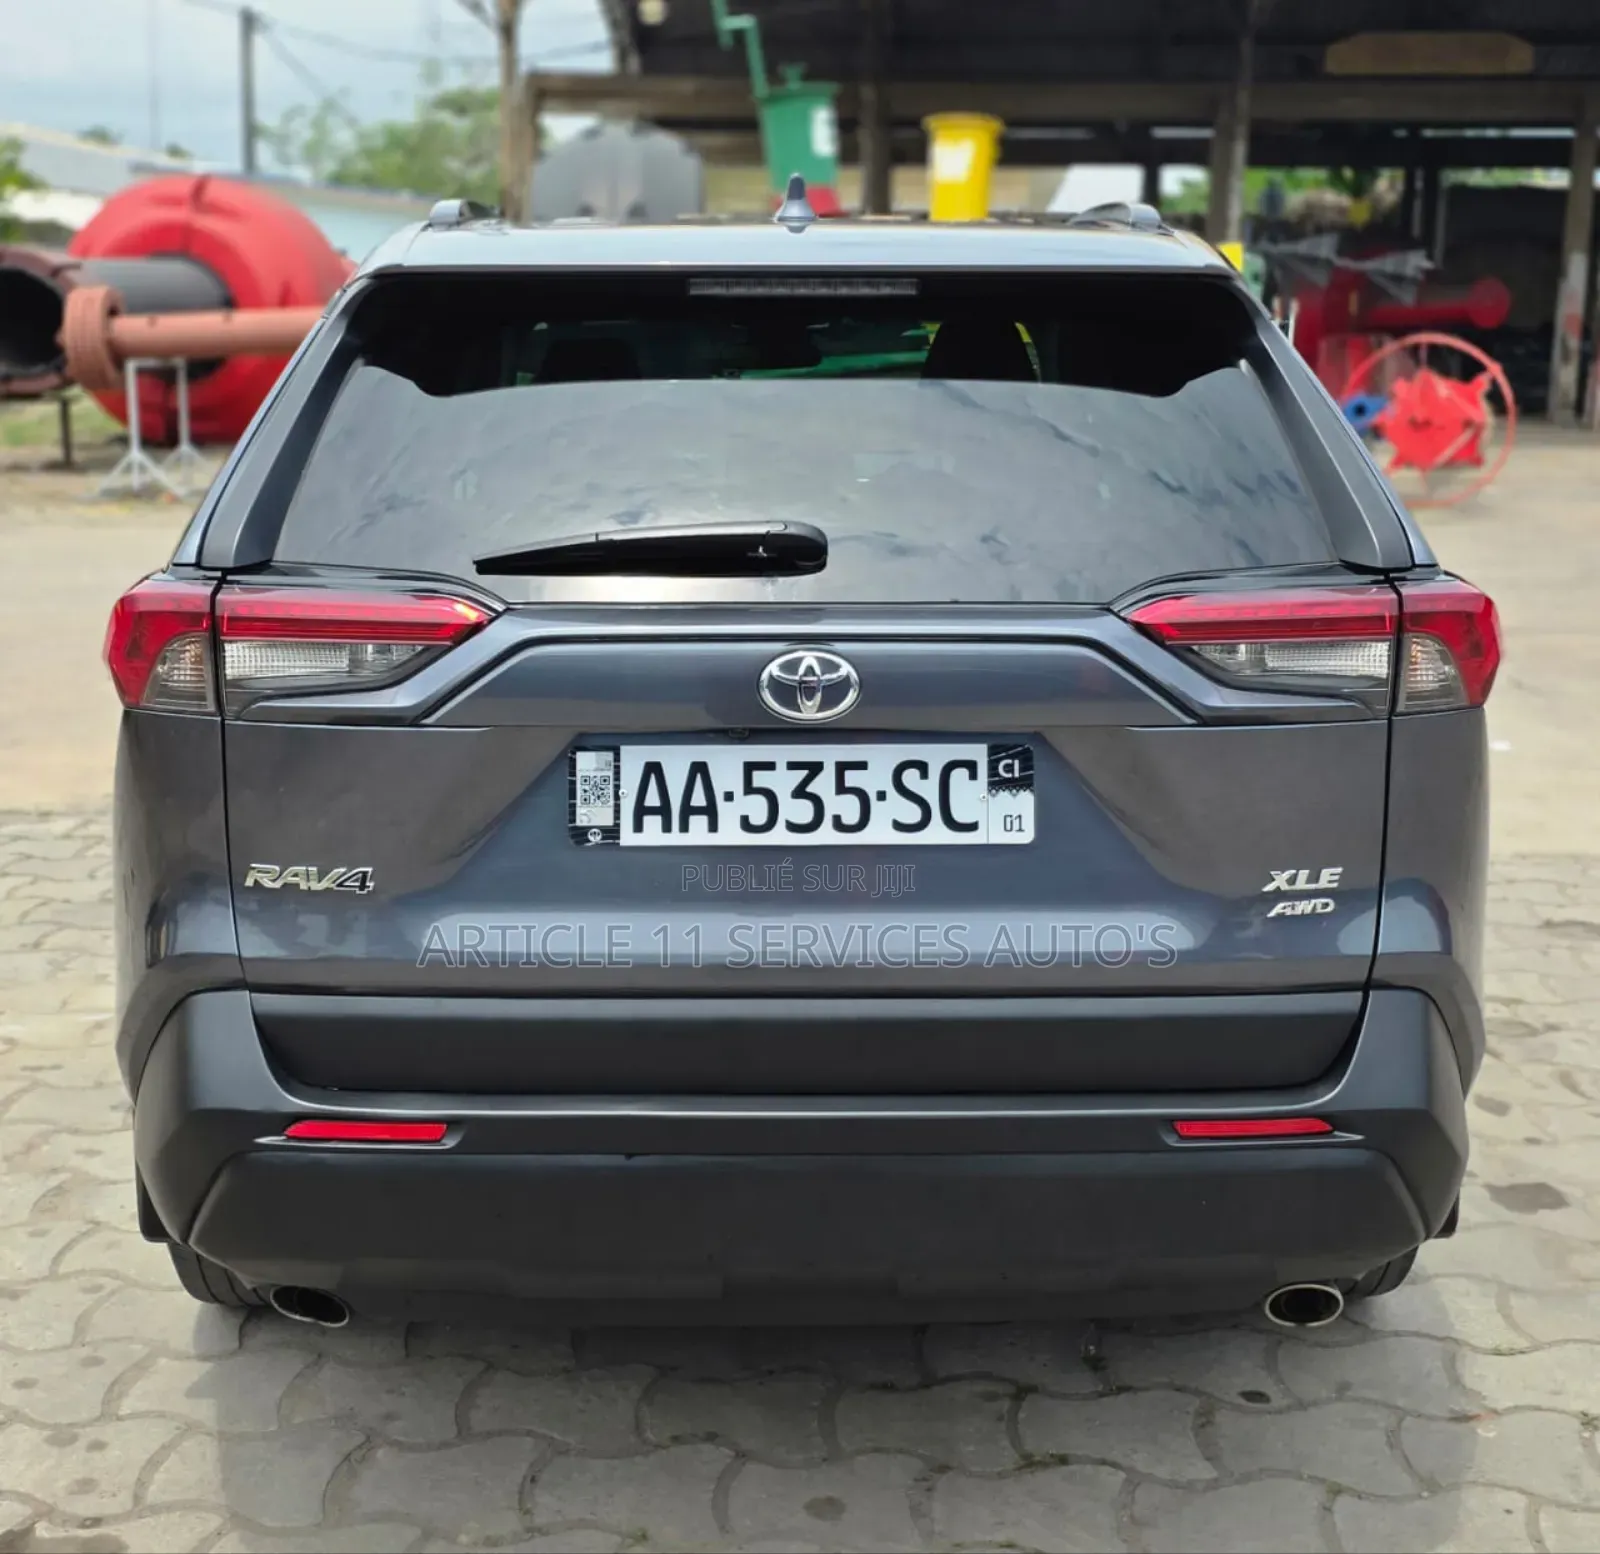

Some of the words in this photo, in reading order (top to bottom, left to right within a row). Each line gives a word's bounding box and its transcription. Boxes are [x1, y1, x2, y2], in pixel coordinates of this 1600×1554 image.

[998, 759, 1020, 779] CI
[1003, 814, 1025, 833] 01
[244, 863, 375, 894] RAV4
[1261, 867, 1343, 892] XLE
[1266, 897, 1335, 918] AWD
